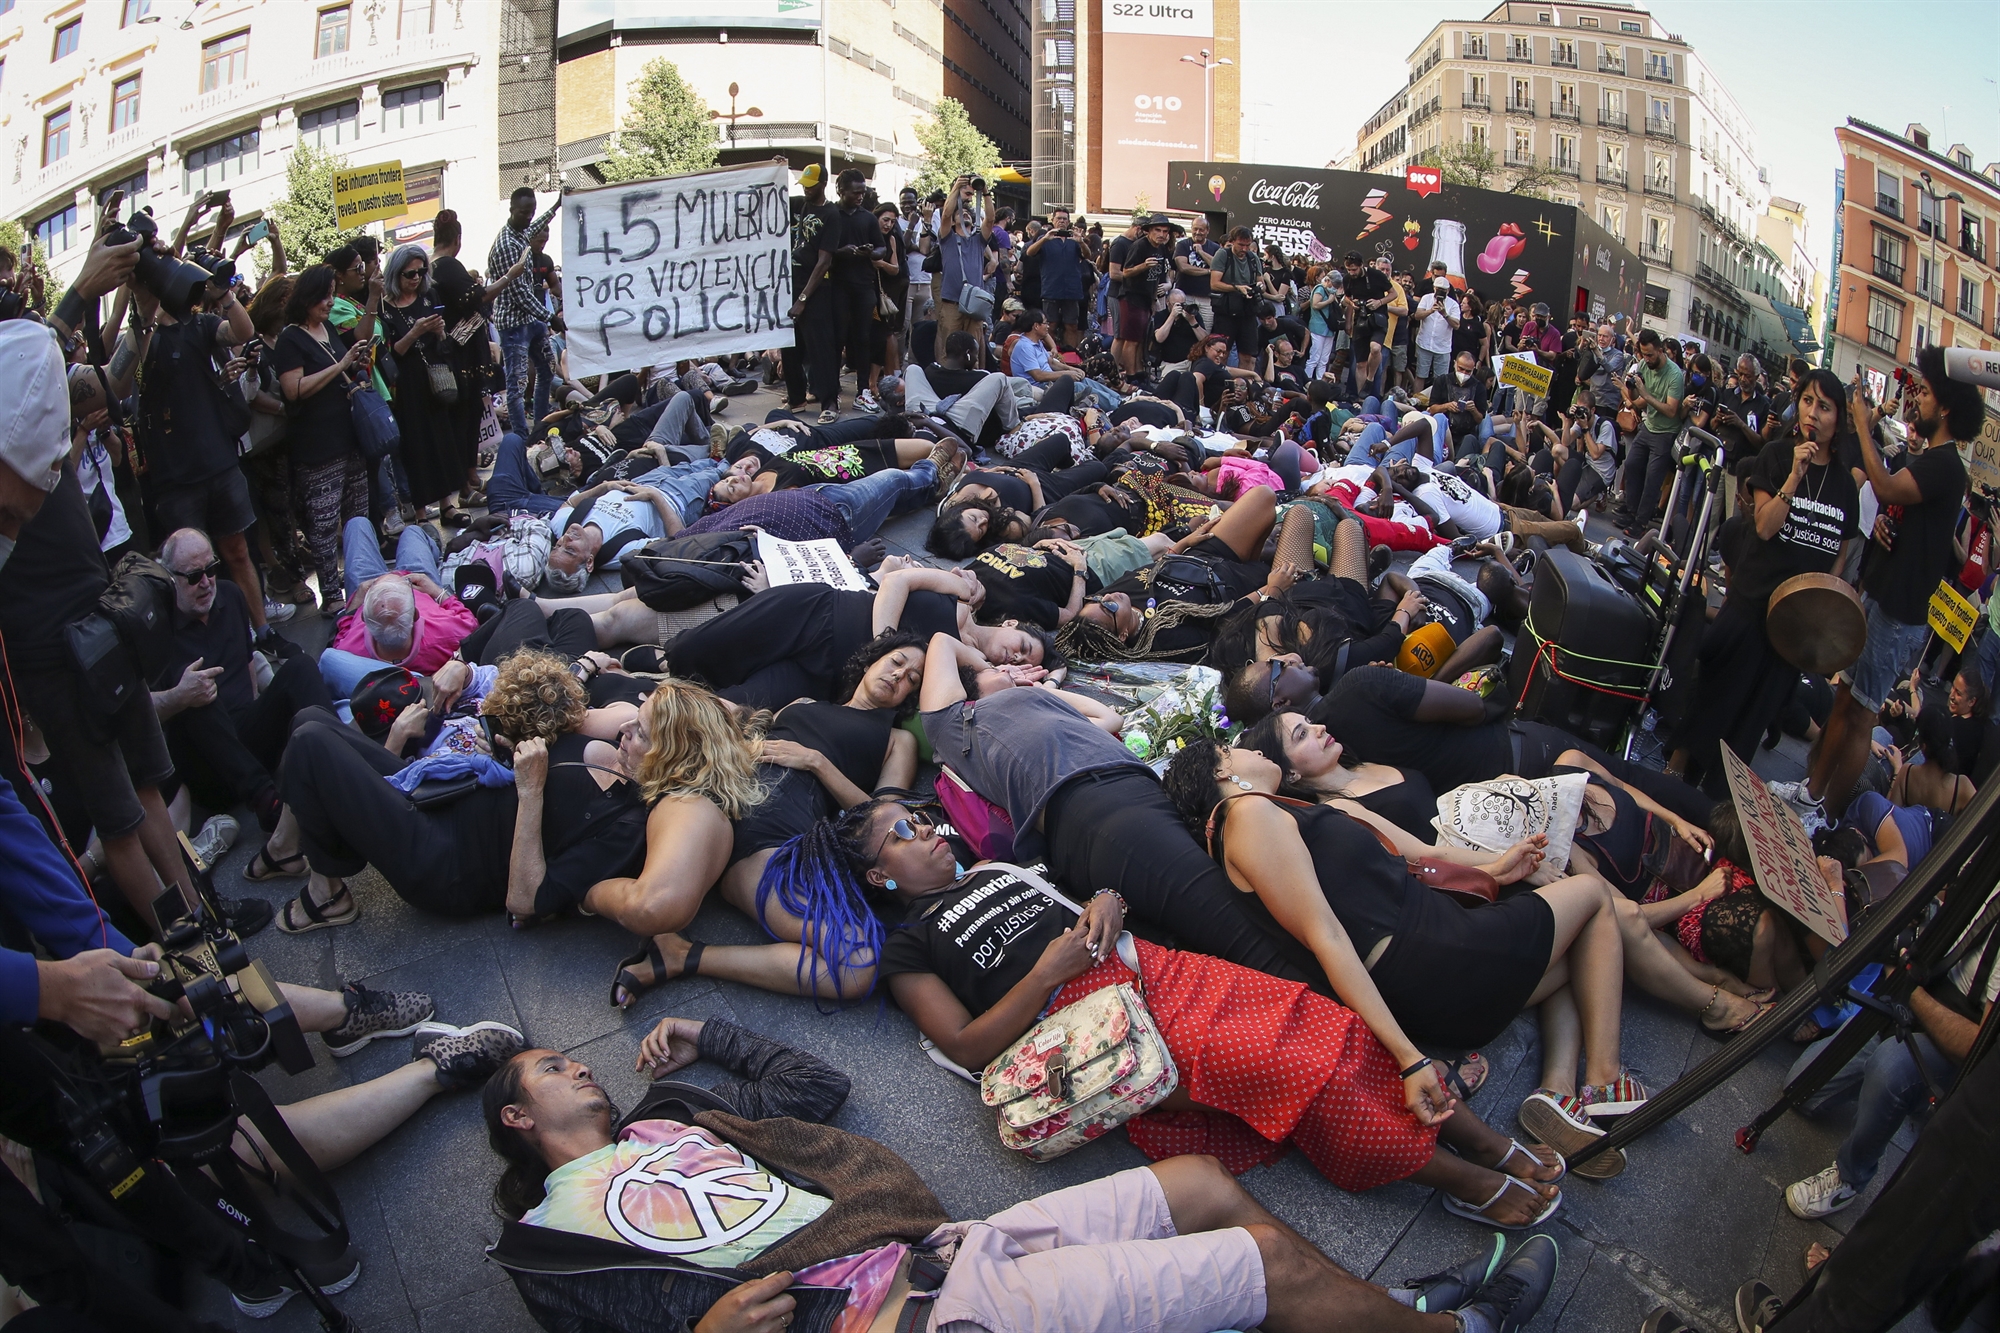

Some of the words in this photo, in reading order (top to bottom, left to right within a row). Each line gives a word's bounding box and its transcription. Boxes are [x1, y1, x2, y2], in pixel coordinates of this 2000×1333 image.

[1113, 4, 1144, 17] S22
[1149, 5, 1193, 19] Ultra
[1134, 94, 1182, 111] 010
[337, 175, 349, 193] Esa
[349, 171, 379, 191] inhumana
[379, 168, 402, 185] frontera
[1410, 172, 1427, 184] 9K
[338, 199, 358, 219] revela
[358, 193, 382, 213] nuestro
[381, 191, 405, 208] sistema.
[1249, 178, 1325, 210] Coca-Cola
[576, 190, 662, 266] 45
[674, 182, 790, 249] MUERTOS
[1252, 224, 1316, 245] #ZERO
[1258, 217, 1278, 225] ZERO
[1280, 217, 1311, 229] AZÚCAR
[576, 272, 635, 307] POR
[647, 248, 791, 297] VIOLENCIA
[599, 290, 795, 356] POLICIAL
[1502, 371, 1512, 380] HOY
[1505, 360, 1518, 371] AYER
[1975, 441, 1996, 465] OUR
[1791, 526, 1821, 544] justicia
[824, 561, 848, 587] SUSPENDE
[1930, 609, 1948, 627] nuestro
[1945, 621, 1965, 644] sistema.
[1954, 602, 1974, 627] frontera
[1729, 751, 1761, 823] RACISTA
[1769, 785, 1801, 855] NEGRAS
[1746, 819, 1787, 902] ESPAÑA
[1788, 817, 1833, 905] MELILLA
[1770, 837, 1810, 922] MASACRA
[1789, 854, 1823, 917] VIDAS
[954, 903, 1004, 948] Permanente
[1001, 900, 1011, 912] y
[1009, 894, 1022, 907] sin
[1826, 902, 1844, 943] EN
[971, 935, 997, 970] por
[994, 904, 1046, 944] justicia
[129, 1173, 140, 1183] 11
[217, 1197, 252, 1227] SONY
